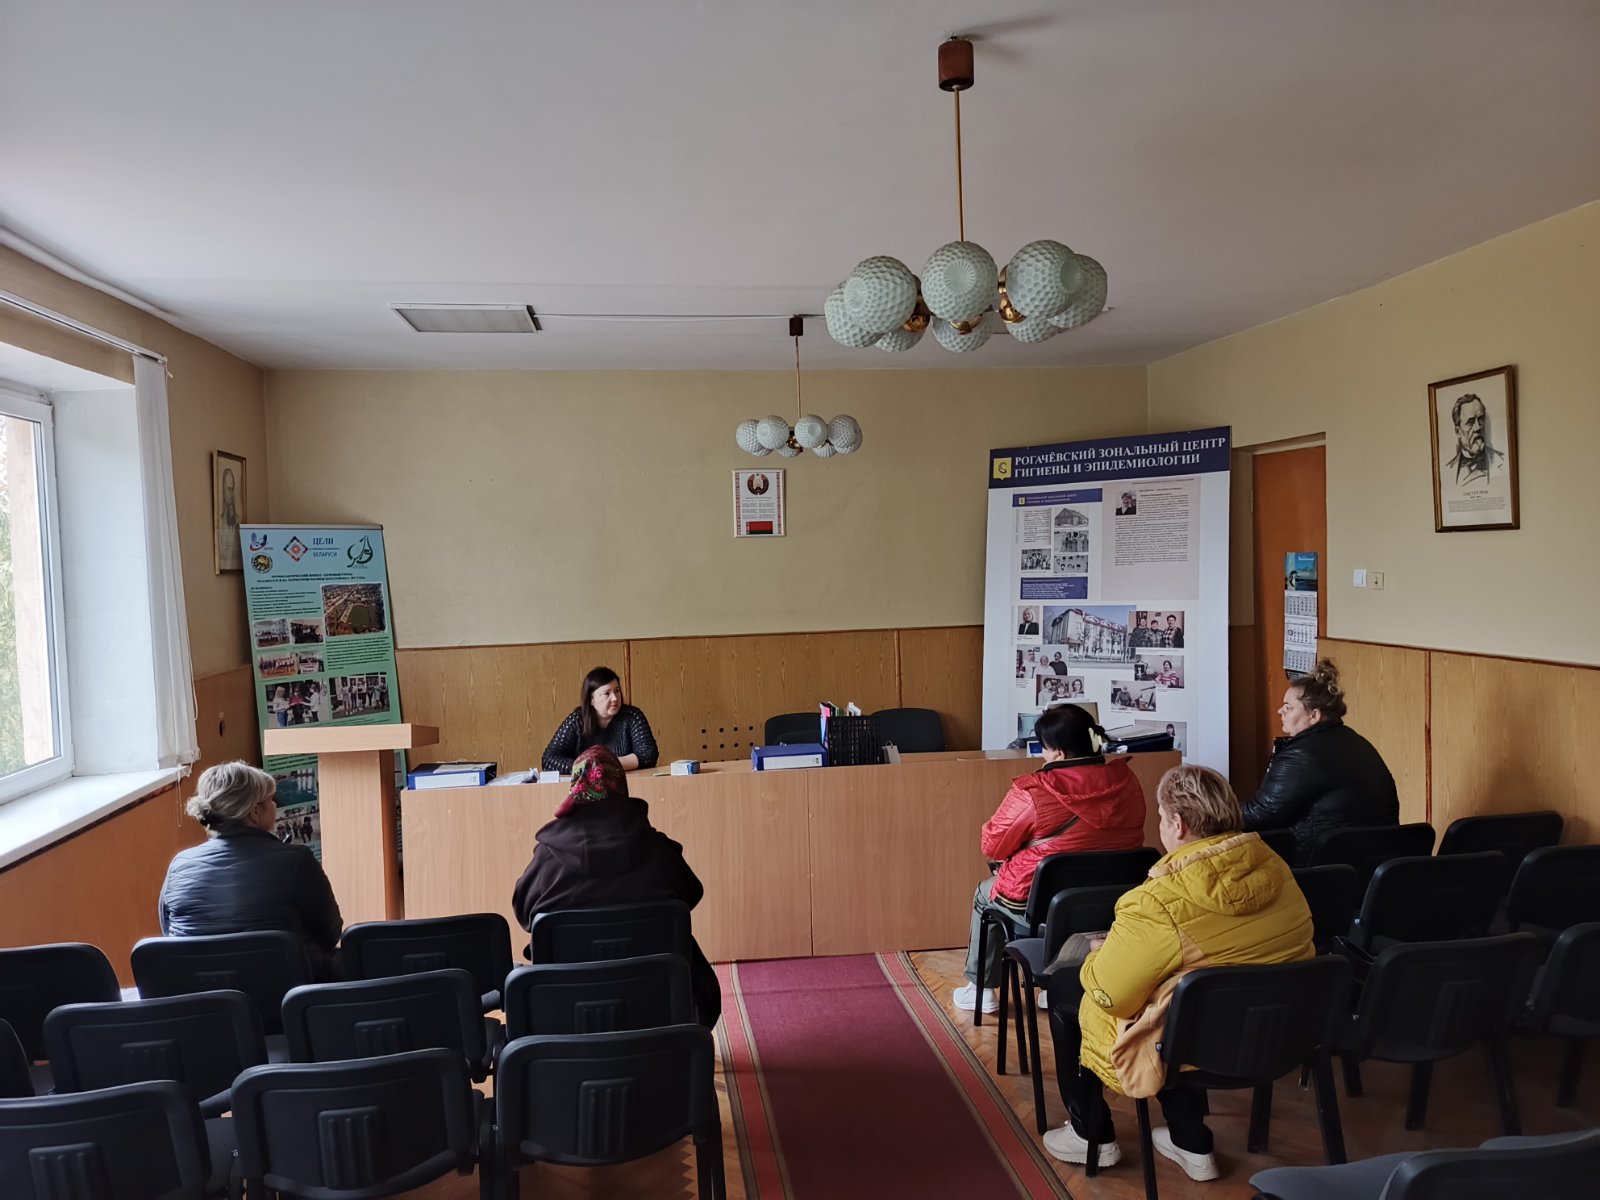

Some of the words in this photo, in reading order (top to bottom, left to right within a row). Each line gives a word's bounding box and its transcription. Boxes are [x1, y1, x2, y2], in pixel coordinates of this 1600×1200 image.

[1015, 448, 1096, 466] РОГАЧЁВСКИЙ
[1098, 440, 1179, 458] ЗОНАЛЬНЫЙ
[1182, 437, 1226, 452] ЦЕНТР
[1014, 464, 1070, 478] ГИГИЕНЫ
[1073, 463, 1082, 473] И
[1084, 453, 1200, 472] ЭПИДЕМИОЛОГИИ
[312, 537, 334, 545] ЦЕЛИ
